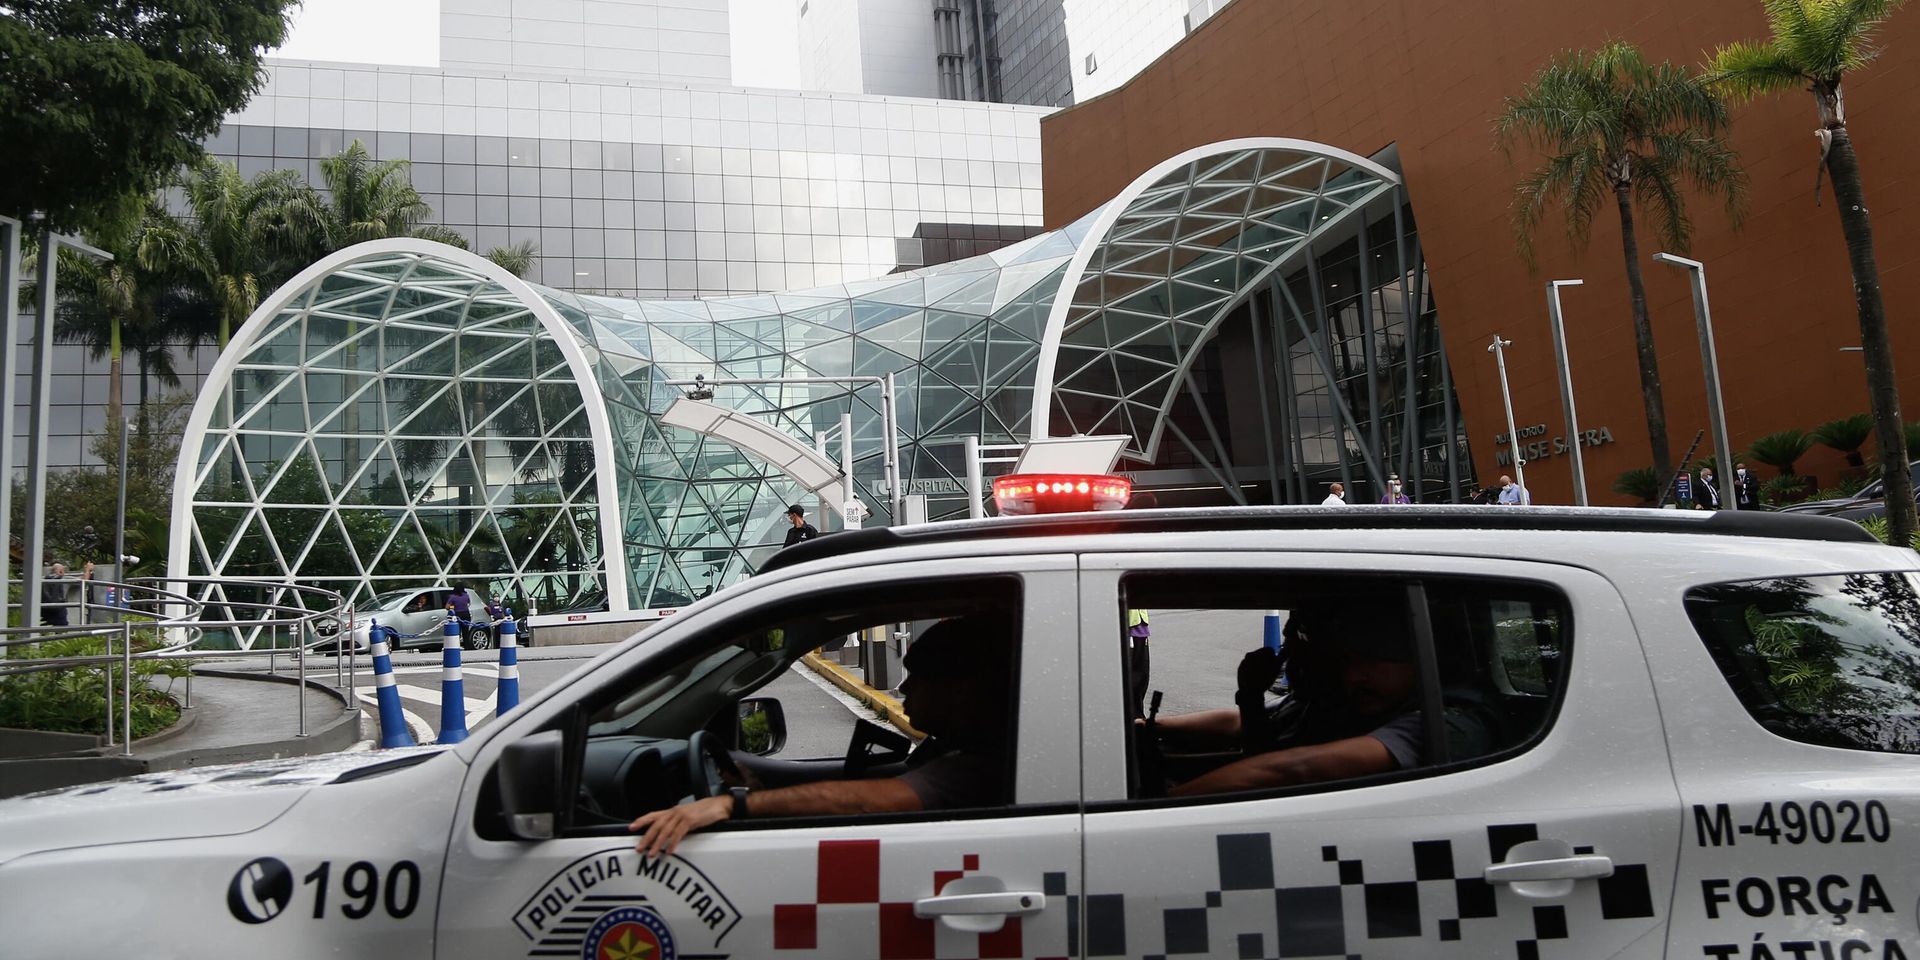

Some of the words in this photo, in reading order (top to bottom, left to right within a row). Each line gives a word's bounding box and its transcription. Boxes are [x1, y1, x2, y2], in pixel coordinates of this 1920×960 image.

[900, 480, 961, 493] HOSPITAL
[1693, 800, 1890, 847] M-49020
[304, 861, 421, 919] 190
[527, 856, 622, 931] POLÍCIA
[636, 855, 726, 930] MILITAR
[1701, 874, 1895, 925] FORÇA
